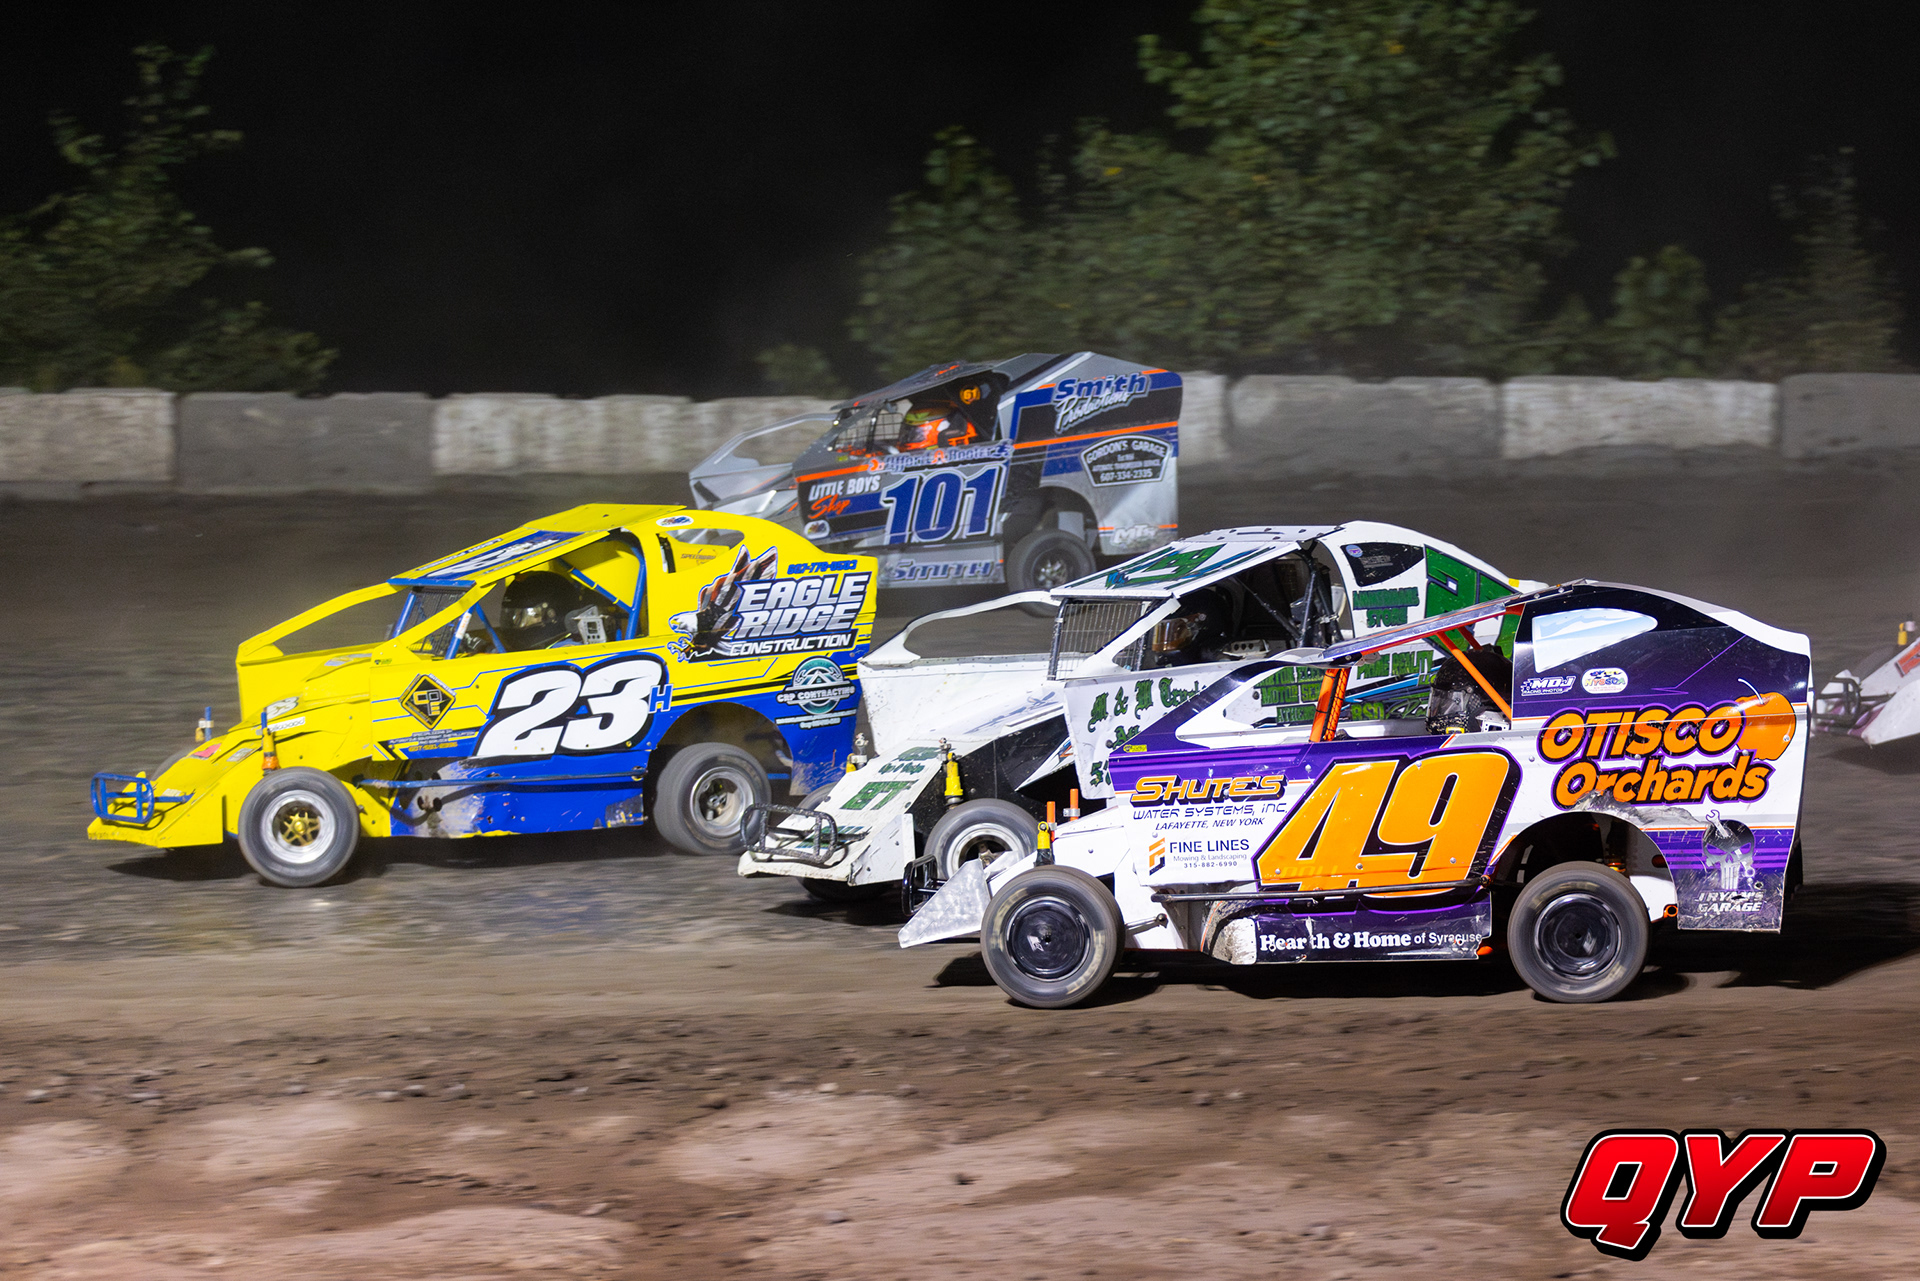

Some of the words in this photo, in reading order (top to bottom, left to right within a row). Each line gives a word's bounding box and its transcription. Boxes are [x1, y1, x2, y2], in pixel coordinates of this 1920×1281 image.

[1054, 373, 1148, 401] Smith
[1086, 440, 1128, 464] GORDON'S
[1132, 440, 1166, 457] GARAGE
[808, 481, 844, 501] LITTLE
[846, 475, 881, 495] BOYS
[808, 493, 850, 519] Shop
[880, 463, 1006, 545] 101
[739, 574, 870, 612] EAGLE
[731, 604, 853, 639] RIDGE
[730, 633, 852, 657] CONSTRUCTION
[797, 684, 856, 701] CONTRACTING
[1531, 676, 1576, 689] MDJ
[474, 659, 664, 757] 23
[649, 684, 673, 714] H
[1114, 686, 1129, 716] &
[1541, 705, 1744, 759] OTISCO
[1131, 774, 1288, 807] SHUTE'S
[1555, 755, 1770, 807] Orchards
[1133, 808, 1183, 820] WATER
[1184, 804, 1255, 818] SYSTEMS,
[1155, 820, 1209, 831] LAFAYETTE,
[1212, 819, 1236, 828] NEW
[1239, 817, 1266, 827] YORK
[1254, 752, 1511, 898] 49
[1169, 841, 1203, 854] FINE
[1207, 839, 1250, 852] LINES
[1173, 855, 1199, 863] Mowing
[1208, 853, 1247, 863] Landscaping
[1183, 860, 1238, 869] 315-882-6990
[1698, 902, 1763, 916] GARAGE
[1260, 933, 1328, 952] Hearth
[1333, 931, 1350, 948] &
[1354, 931, 1411, 948] Home
[1414, 933, 1427, 945] of
[1428, 932, 1483, 946] Syracuse
